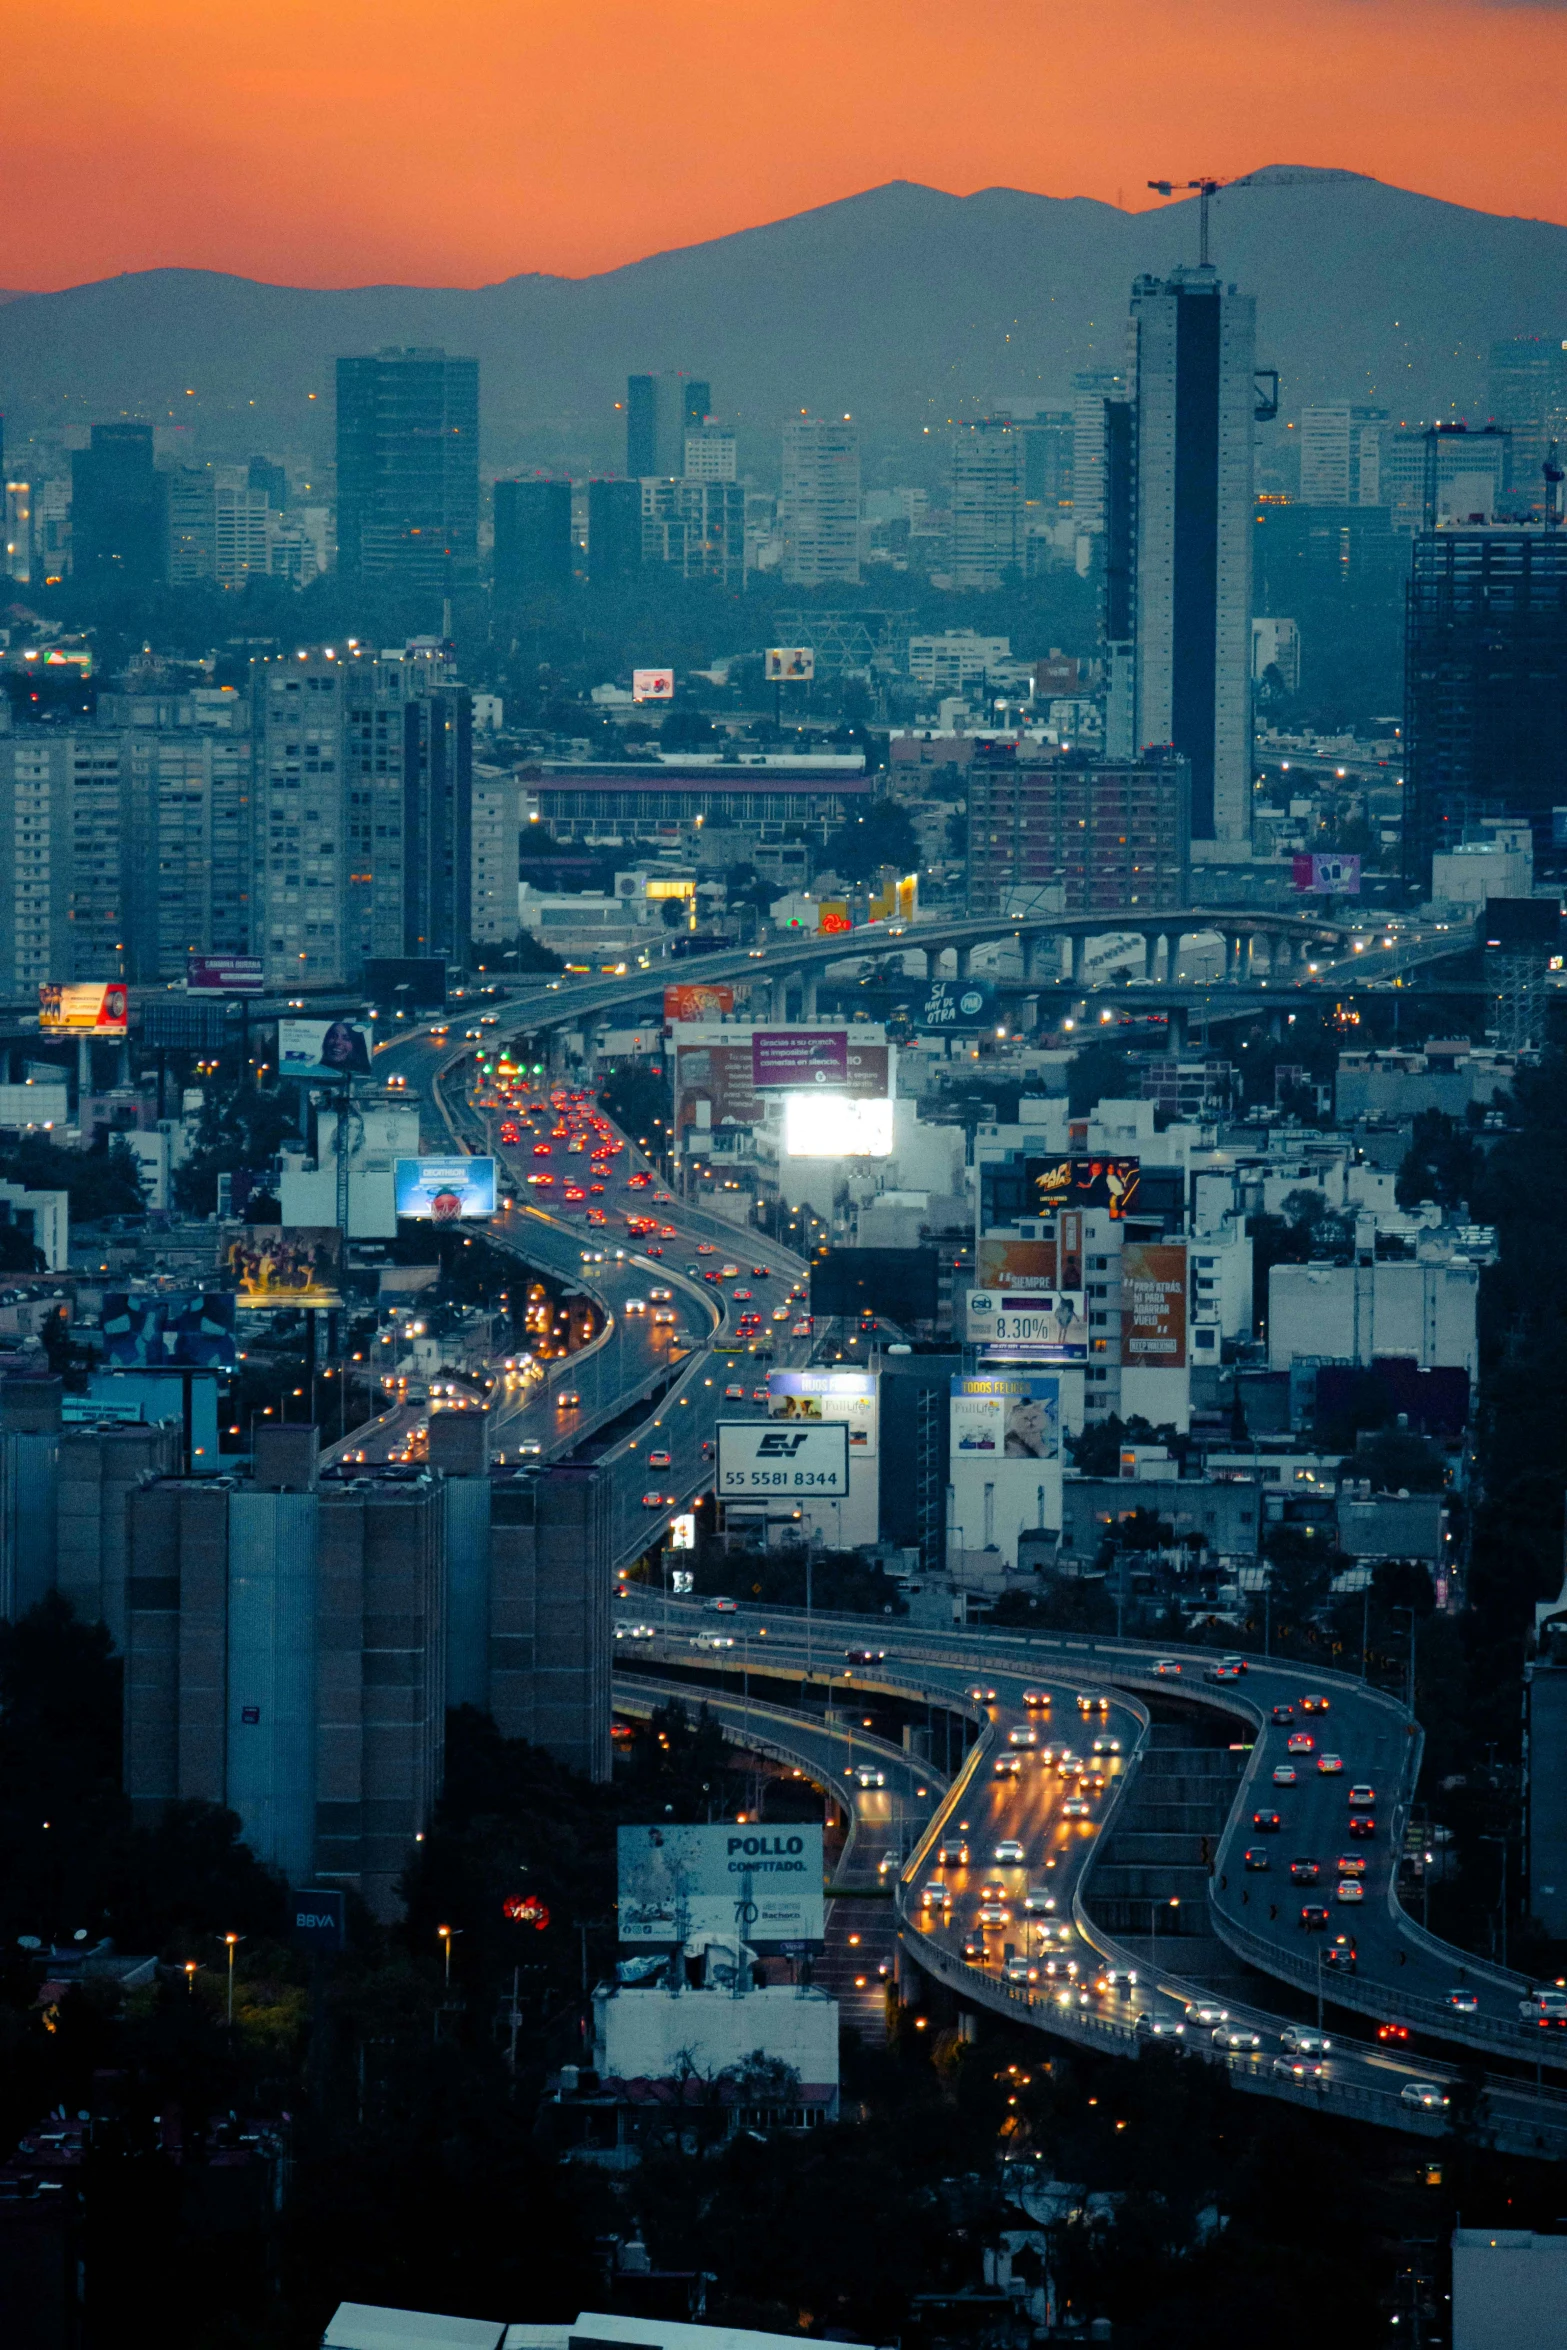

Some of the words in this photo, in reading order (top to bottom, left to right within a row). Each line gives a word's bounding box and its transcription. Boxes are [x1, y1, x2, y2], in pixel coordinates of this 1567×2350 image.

[931, 983, 946, 1000] SÍ
[943, 997, 954, 1008] DE
[927, 1008, 956, 1024] OTRA
[423, 1168, 465, 1176] DECATHLON
[1134, 1282, 1154, 1292] PARA
[972, 1298, 992, 1308] csb
[1144, 1292, 1165, 1303] PARA
[996, 1318, 1048, 1340] 8.30%
[802, 1378, 827, 1392] HIJOS
[963, 1381, 992, 1394] TODOS
[726, 1472, 744, 1485] 55
[752, 1472, 788, 1485] 5581
[794, 1472, 837, 1485] 8344
[727, 1836, 804, 1856] POLLO
[728, 1860, 806, 1872] CONFITADO.
[733, 1901, 758, 1924] 70
[296, 1913, 334, 1928] BBVA
